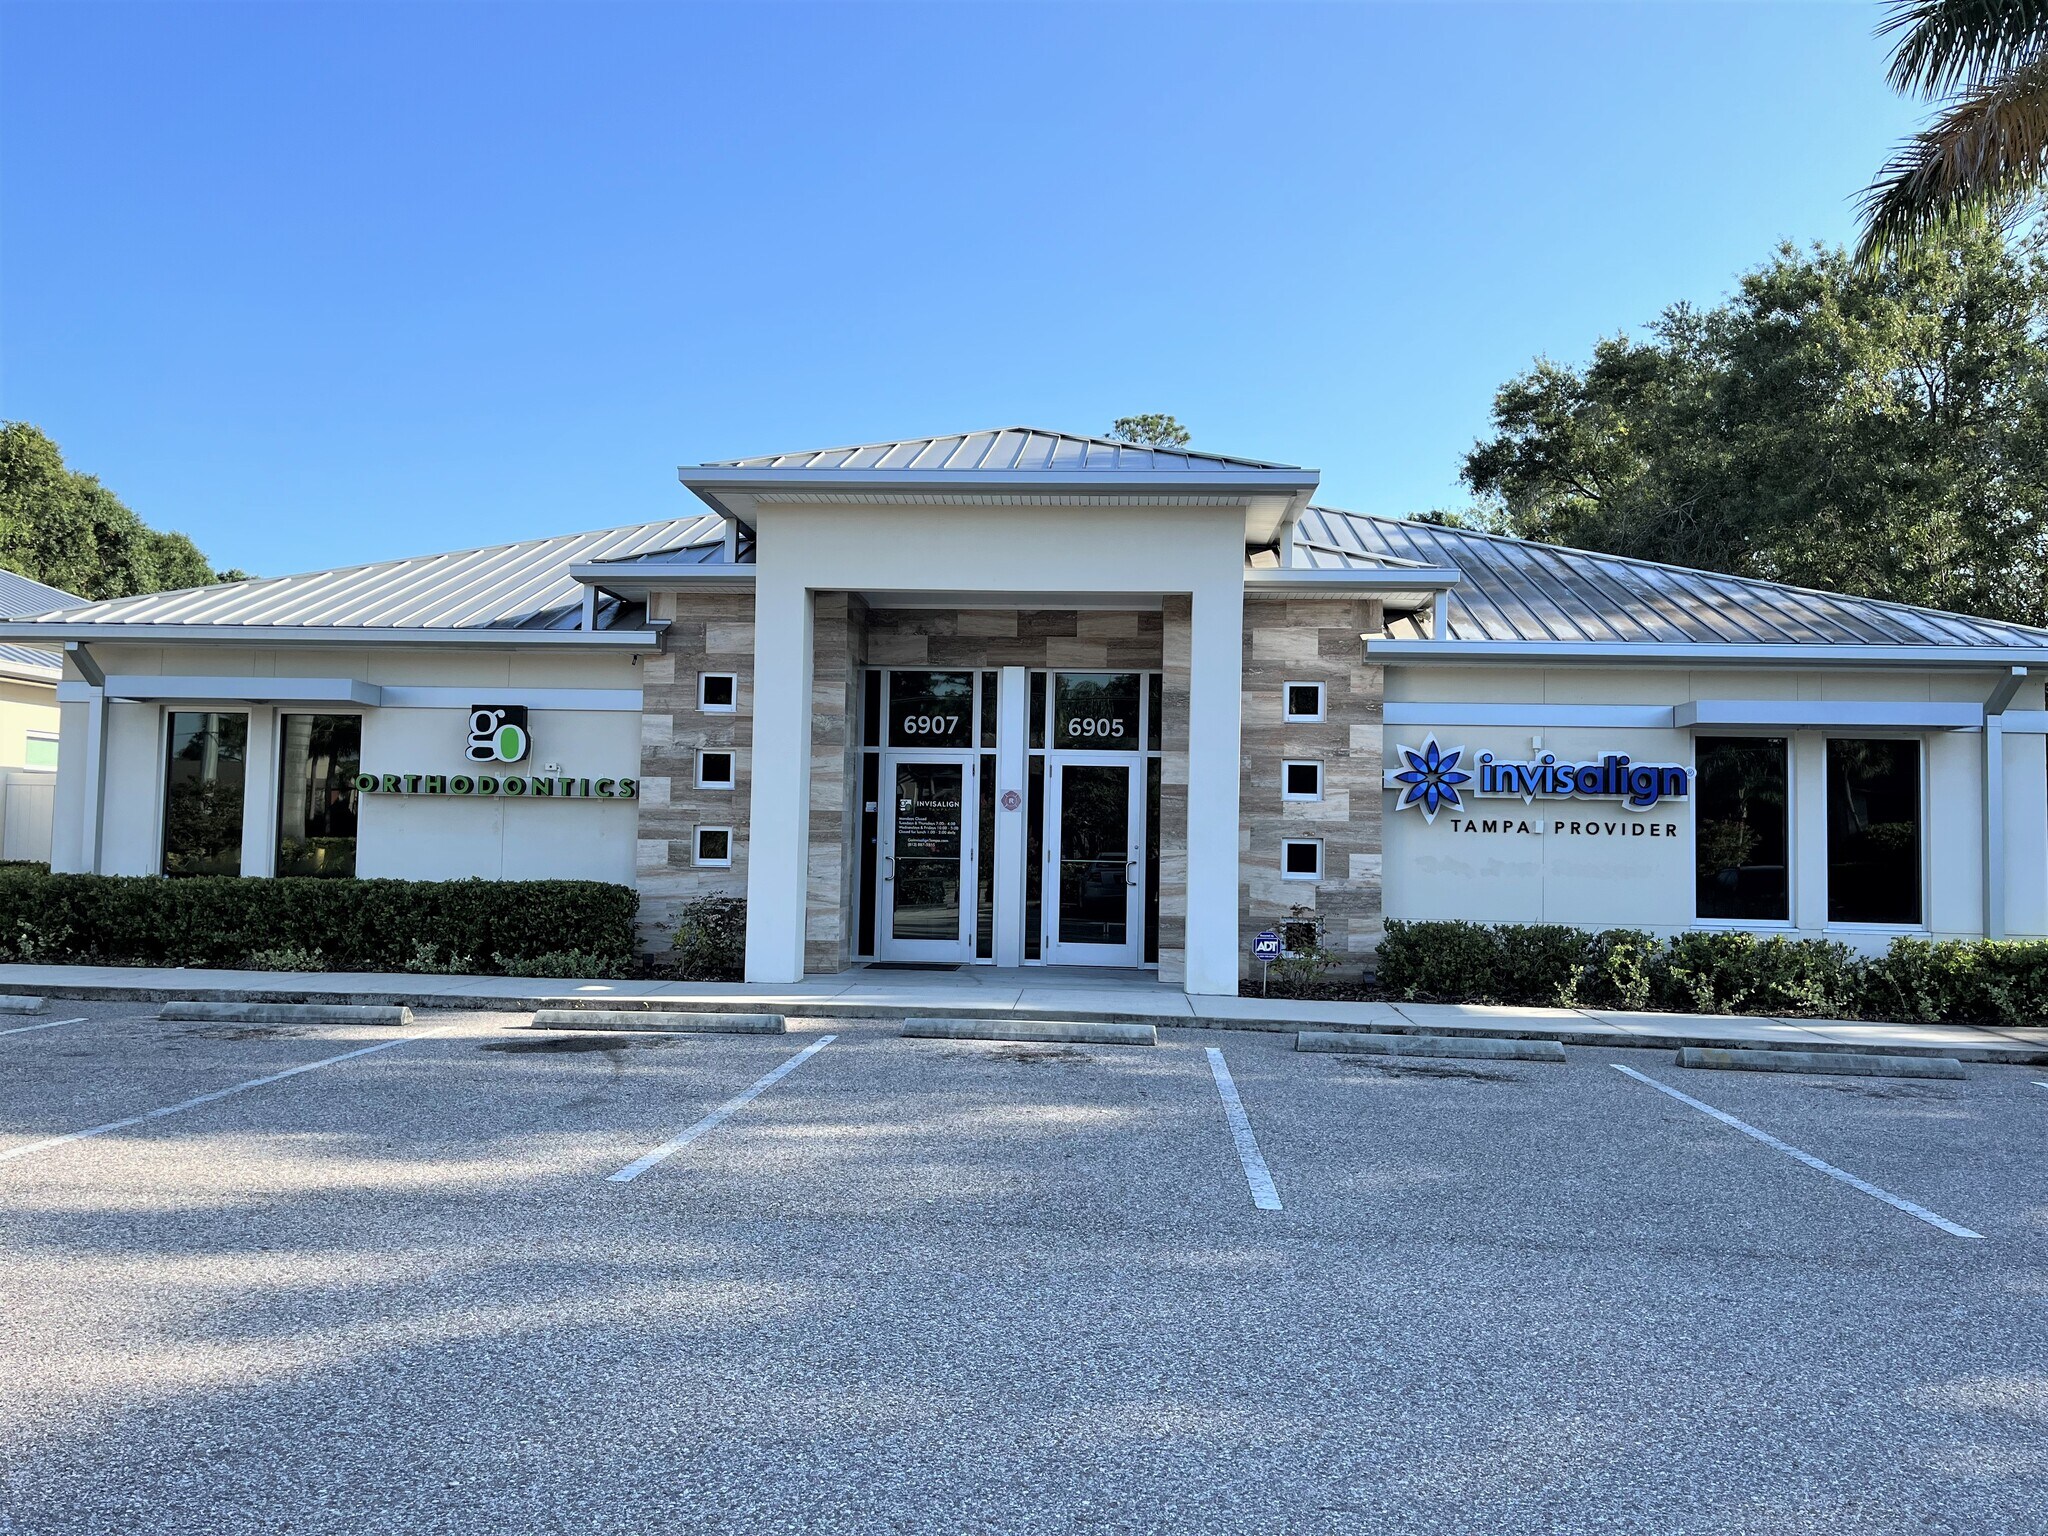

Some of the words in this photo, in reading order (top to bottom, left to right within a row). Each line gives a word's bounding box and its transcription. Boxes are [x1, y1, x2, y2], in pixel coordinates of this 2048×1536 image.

[903, 715, 959, 735] 6907
[1068, 717, 1124, 737] 6905
[465, 709, 528, 763] go
[355, 773, 638, 798] ORTHODONTICS
[916, 800, 960, 808] INVISALIGN
[1451, 819, 1530, 834] TAMPA
[1554, 821, 1677, 837] PROVIDER
[1256, 941, 1277, 952] ADT
